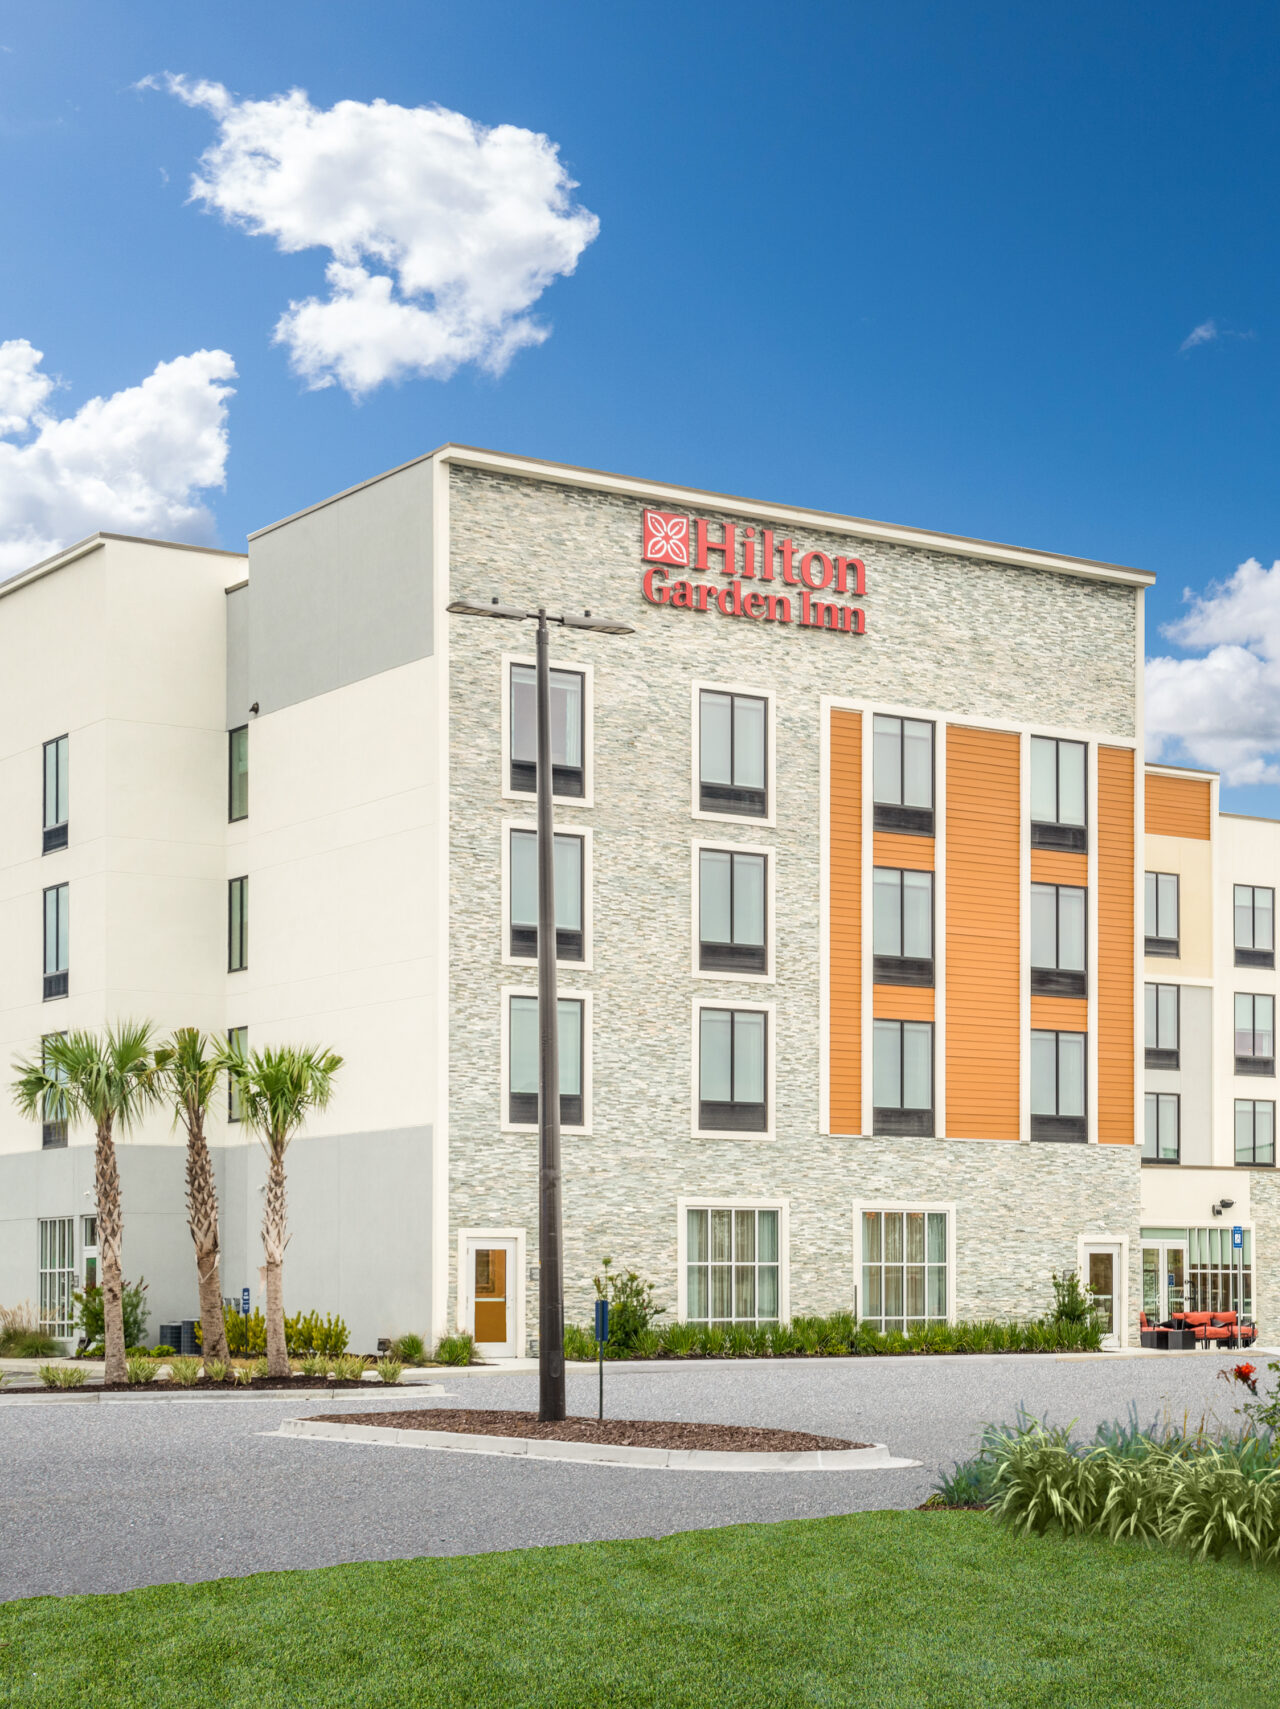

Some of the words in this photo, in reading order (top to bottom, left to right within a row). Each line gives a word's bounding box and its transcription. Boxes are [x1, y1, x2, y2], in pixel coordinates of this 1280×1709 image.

[694, 517, 868, 596] Hilton
[642, 567, 794, 623] Garden
[798, 590, 868, 635] Inn
